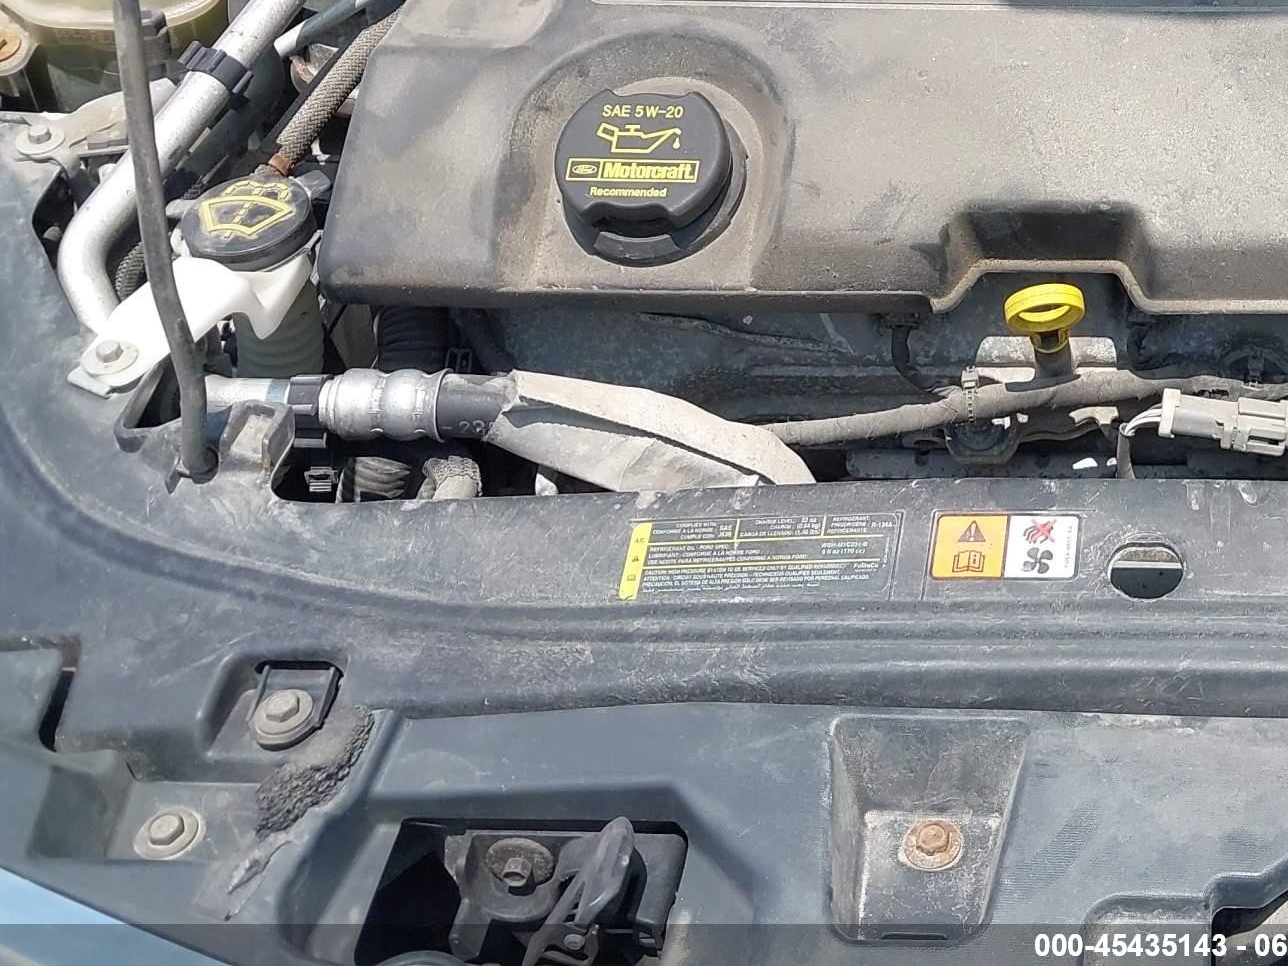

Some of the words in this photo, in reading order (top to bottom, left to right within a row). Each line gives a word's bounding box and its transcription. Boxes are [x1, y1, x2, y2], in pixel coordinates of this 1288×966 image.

[602, 104, 631, 117] SAE
[635, 105, 684, 118] 5W-20
[589, 186, 667, 197] Recommended
